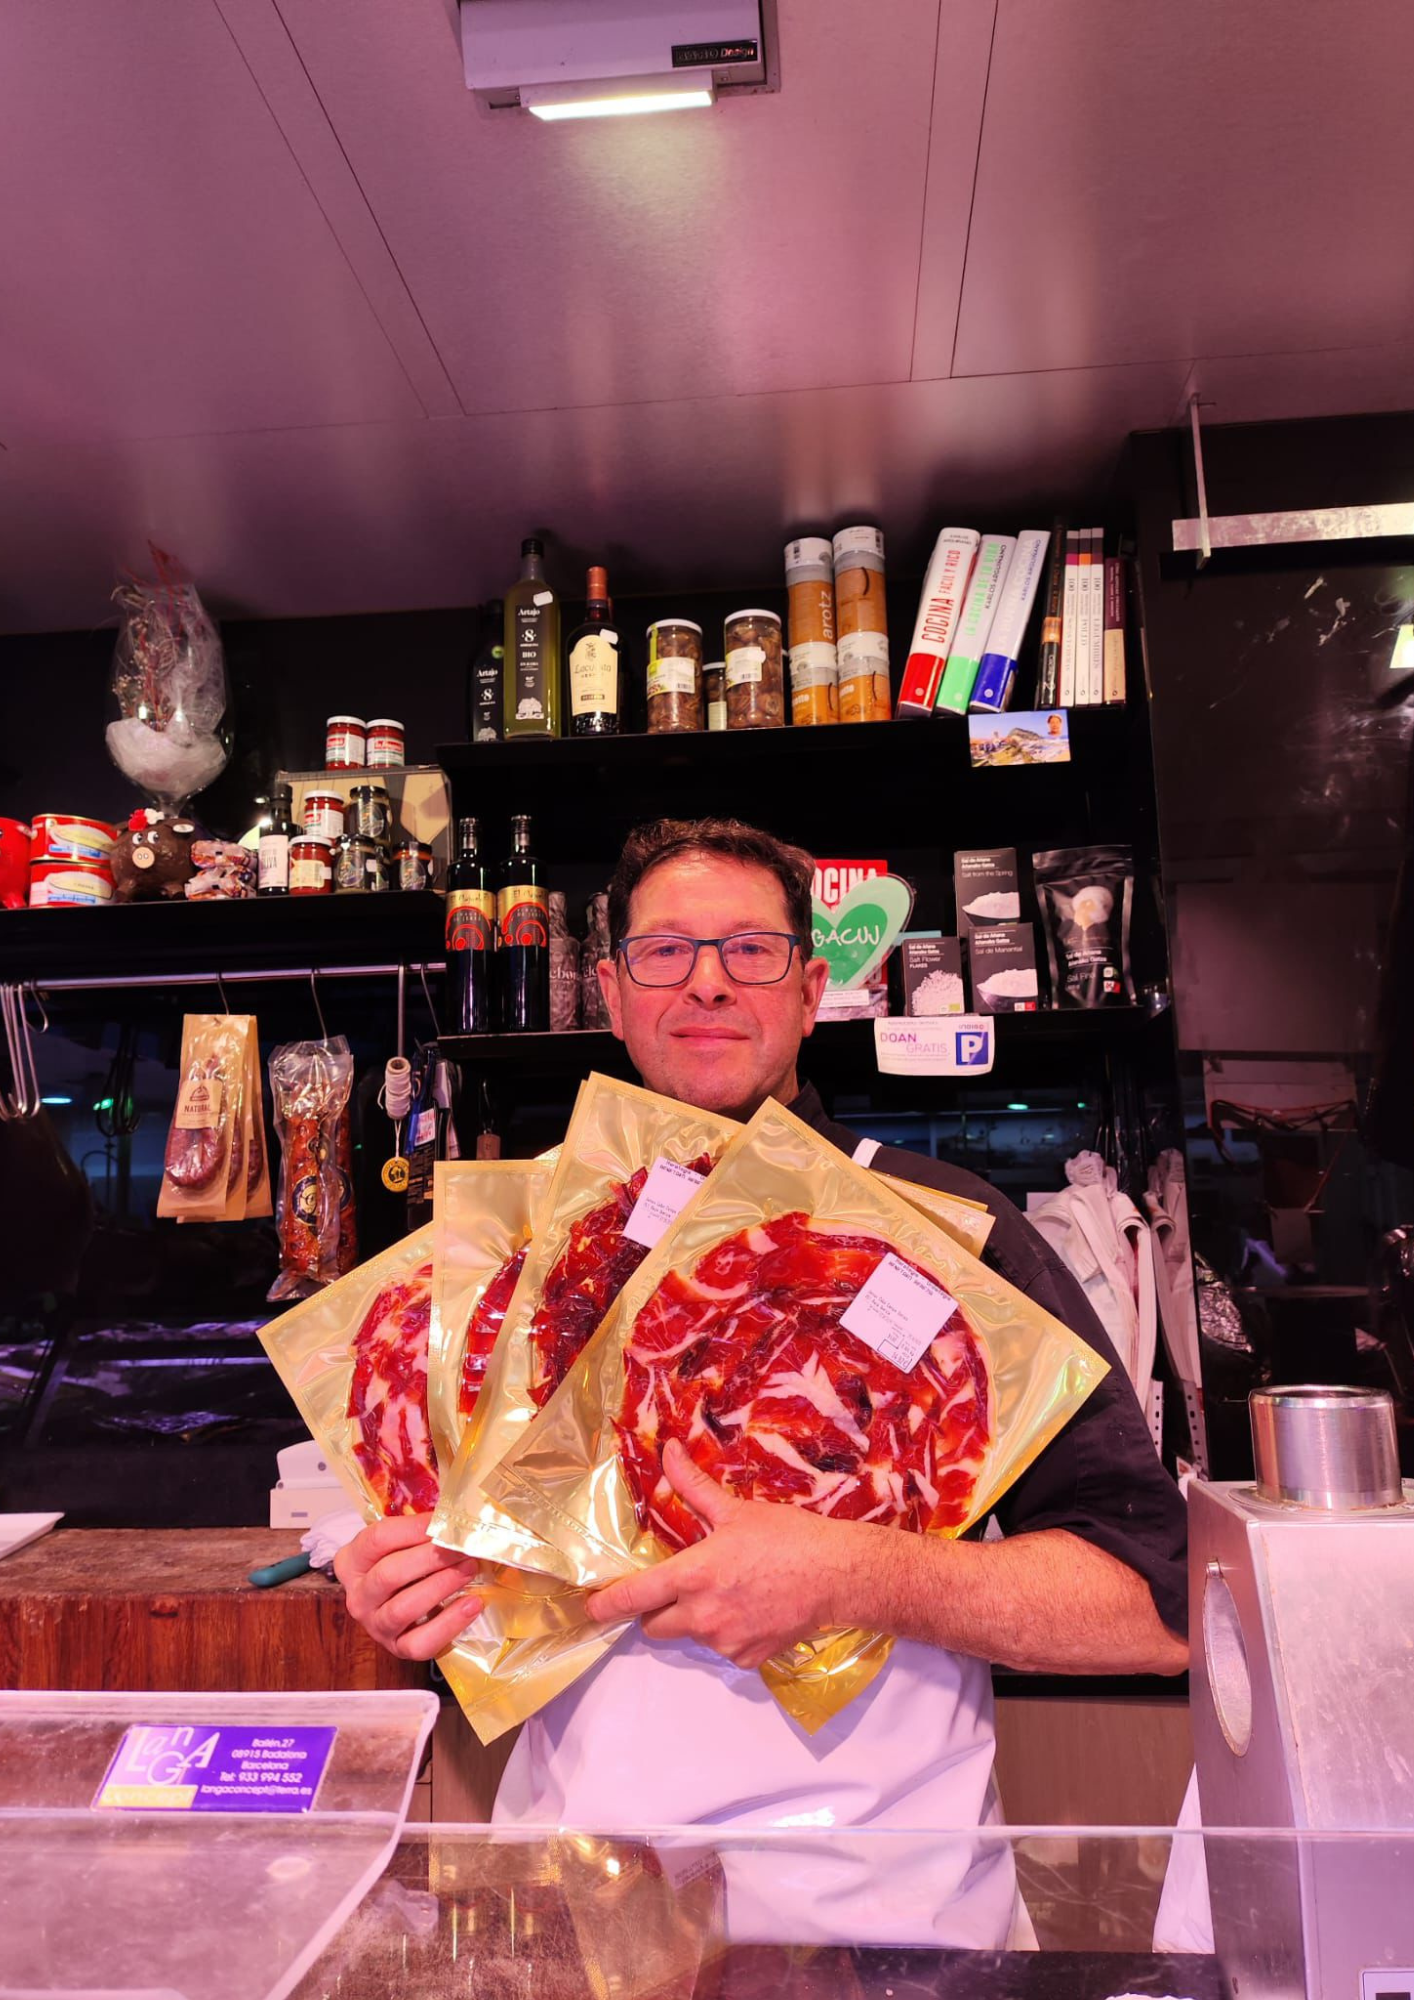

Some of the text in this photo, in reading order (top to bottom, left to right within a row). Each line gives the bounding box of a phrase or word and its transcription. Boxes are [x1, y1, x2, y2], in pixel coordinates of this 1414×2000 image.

[1020, 577, 1031, 601] KARLOS
[921, 597, 955, 644] COCINA
[945, 549, 961, 569] RICO
[984, 583, 996, 609] KARLOS
[518, 608, 541, 617] Artajo
[818, 590, 834, 640] arotz
[476, 669, 499, 678] Artajo
[995, 869, 1013, 878] Spring
[995, 946, 1023, 954] Manantial
[1067, 973, 1079, 983] Sal
[880, 1032, 917, 1043] DOAN
[906, 1043, 948, 1054] GRATIS
[961, 1034, 983, 1063] P
[231, 1750, 307, 1760] 08915 Badalona
[241, 1761, 289, 1770] Barcelona
[238, 1772, 259, 1783] 933
[260, 1772, 280, 1783] 994
[281, 1772, 303, 1783] 552
